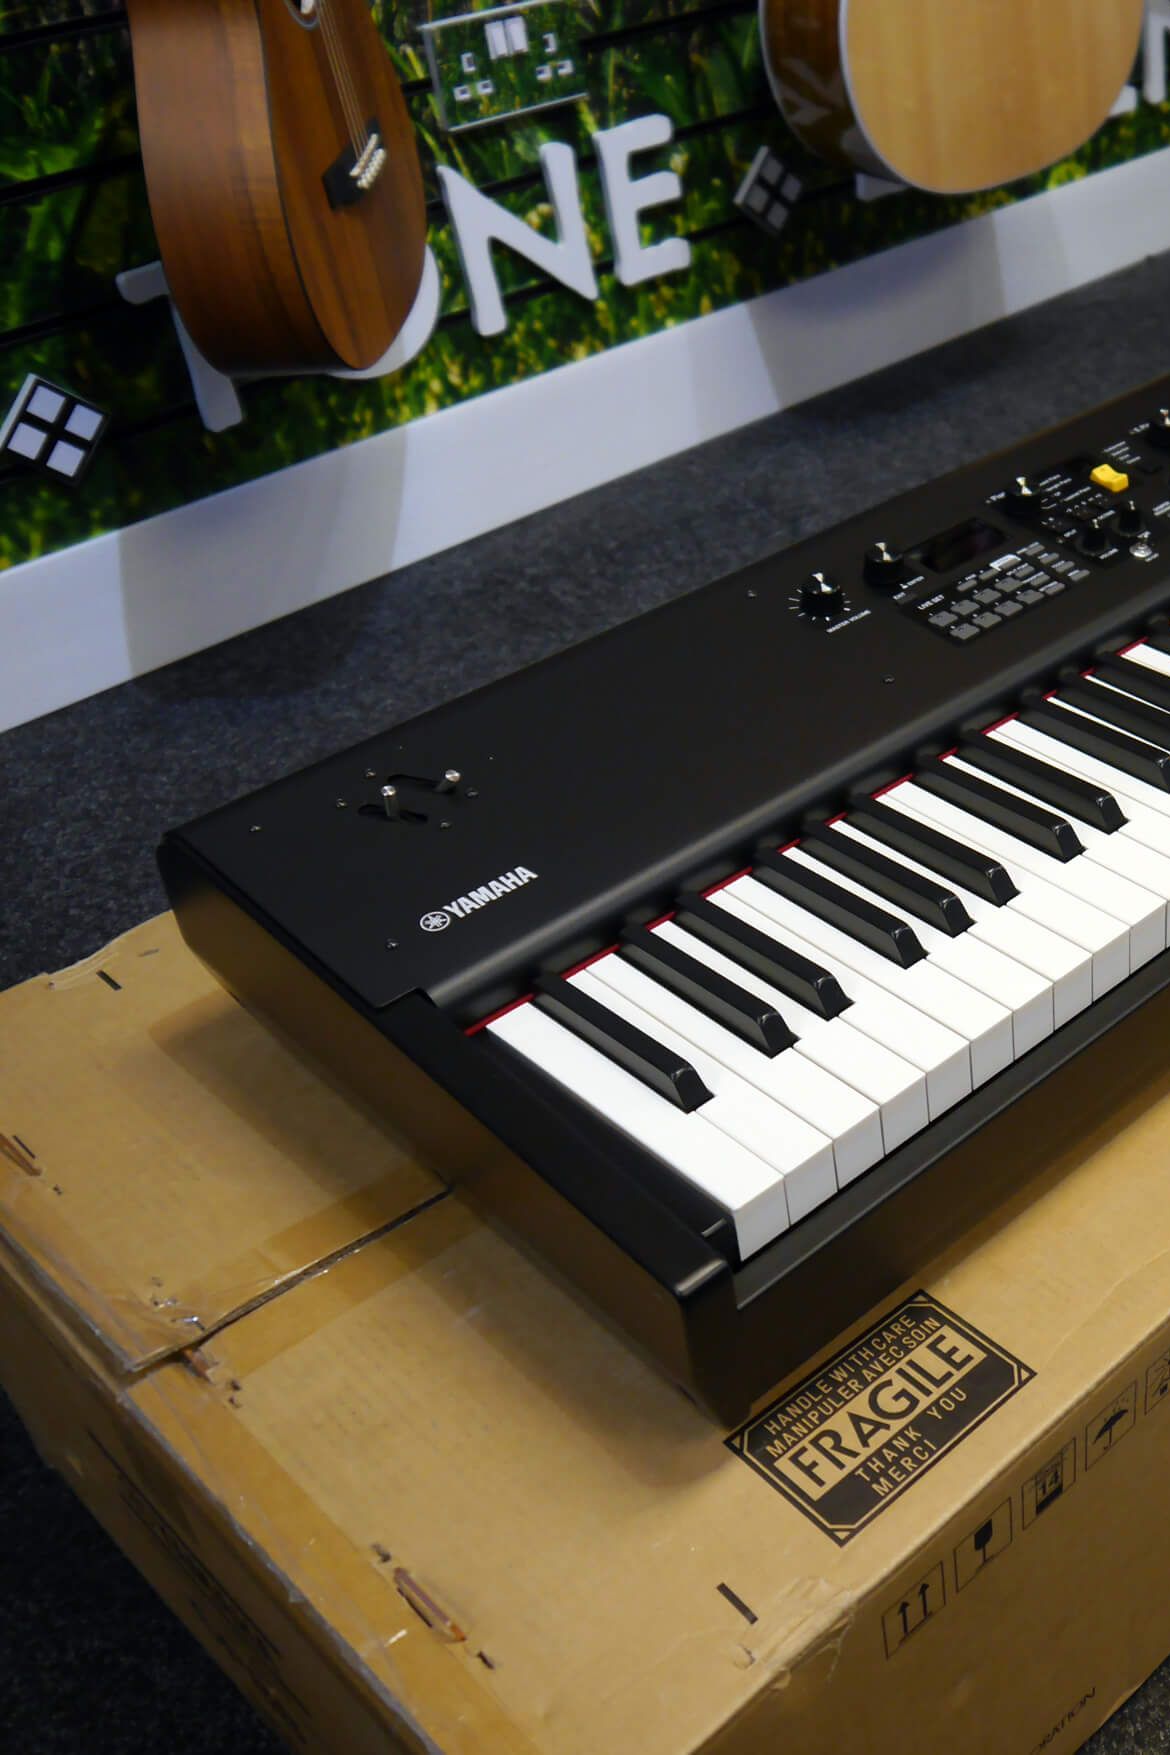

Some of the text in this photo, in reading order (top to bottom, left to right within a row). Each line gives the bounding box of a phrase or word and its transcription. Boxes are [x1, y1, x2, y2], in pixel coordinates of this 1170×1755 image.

[443, 865, 538, 920] YAMAHA
[764, 1314, 916, 1435] HANDLE WITH CARE
[765, 1317, 941, 1459] MANIPULER AVEC SOIN
[787, 1333, 975, 1488] FRAGILE
[854, 1388, 968, 1483] THANK YOU
[870, 1439, 937, 1498] MERCI
